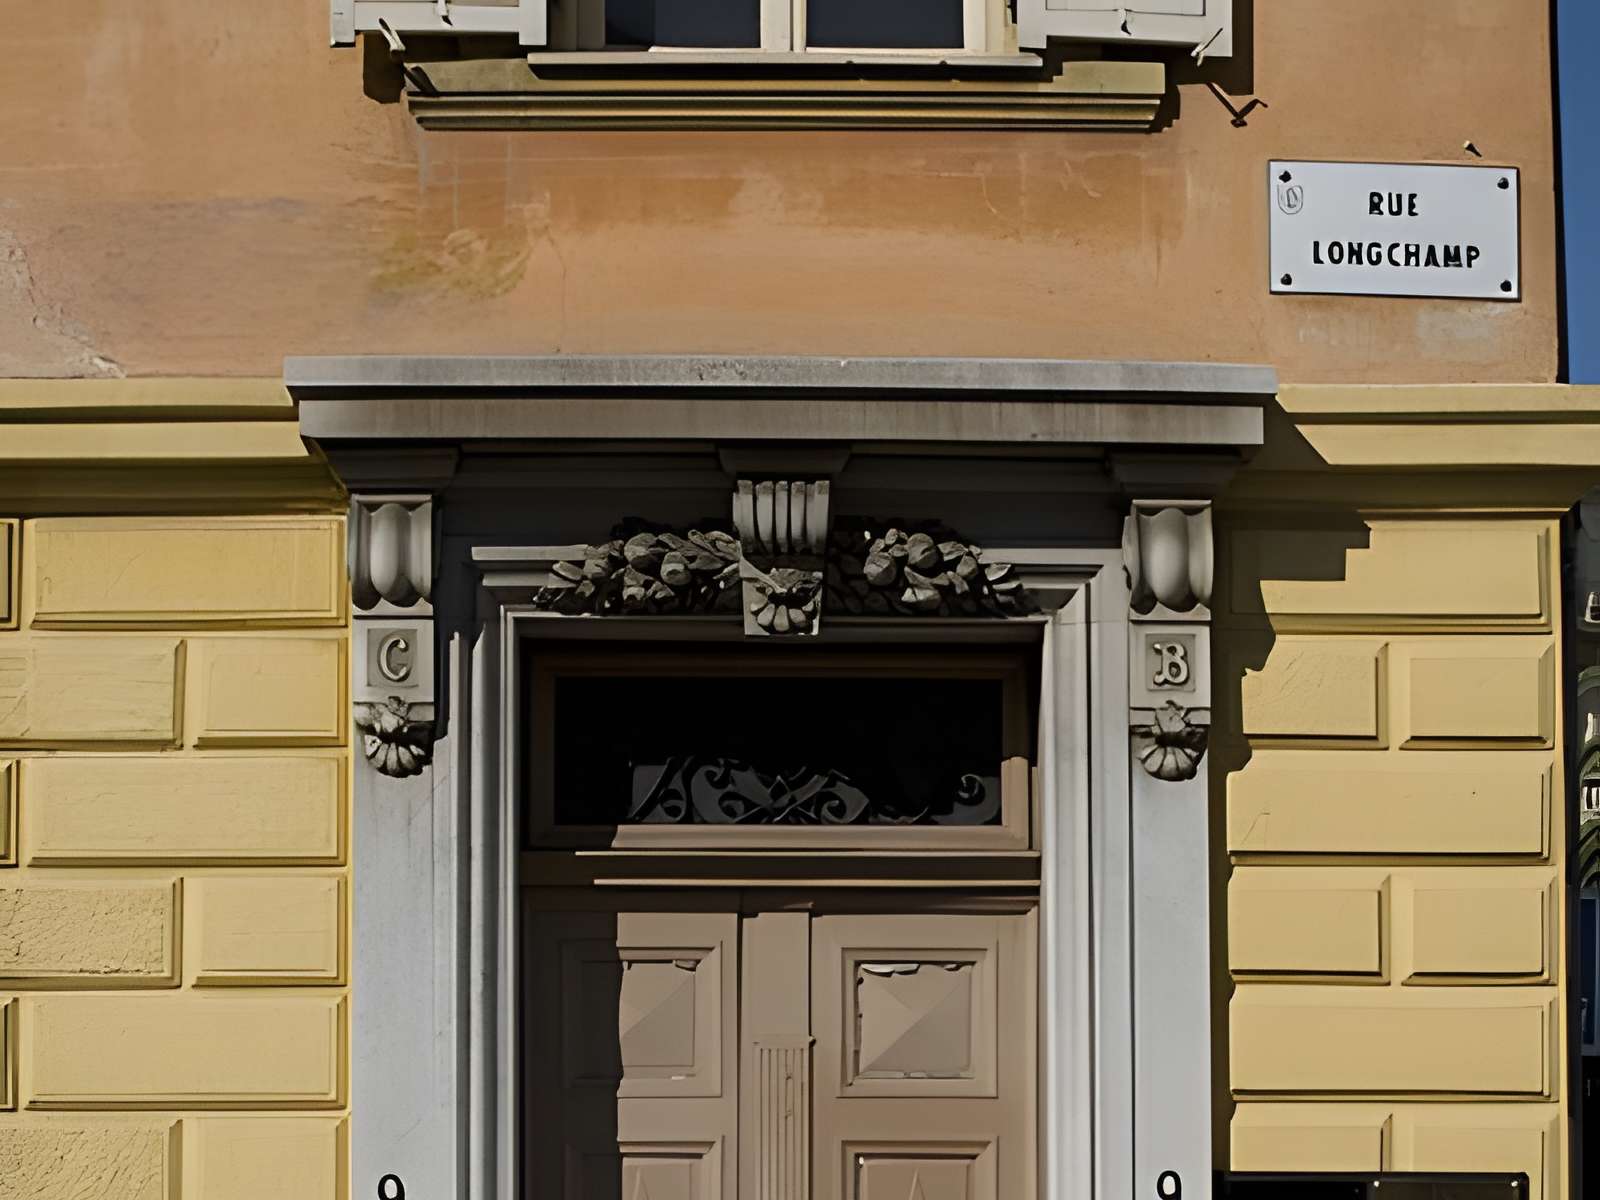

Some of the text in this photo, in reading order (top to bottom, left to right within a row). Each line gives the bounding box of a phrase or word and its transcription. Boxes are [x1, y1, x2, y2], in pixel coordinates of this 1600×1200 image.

[1368, 191, 1419, 217] RUE
[1312, 240, 1481, 269] LONGCHAMP
[377, 634, 411, 683] C
[1152, 642, 1190, 686] B
